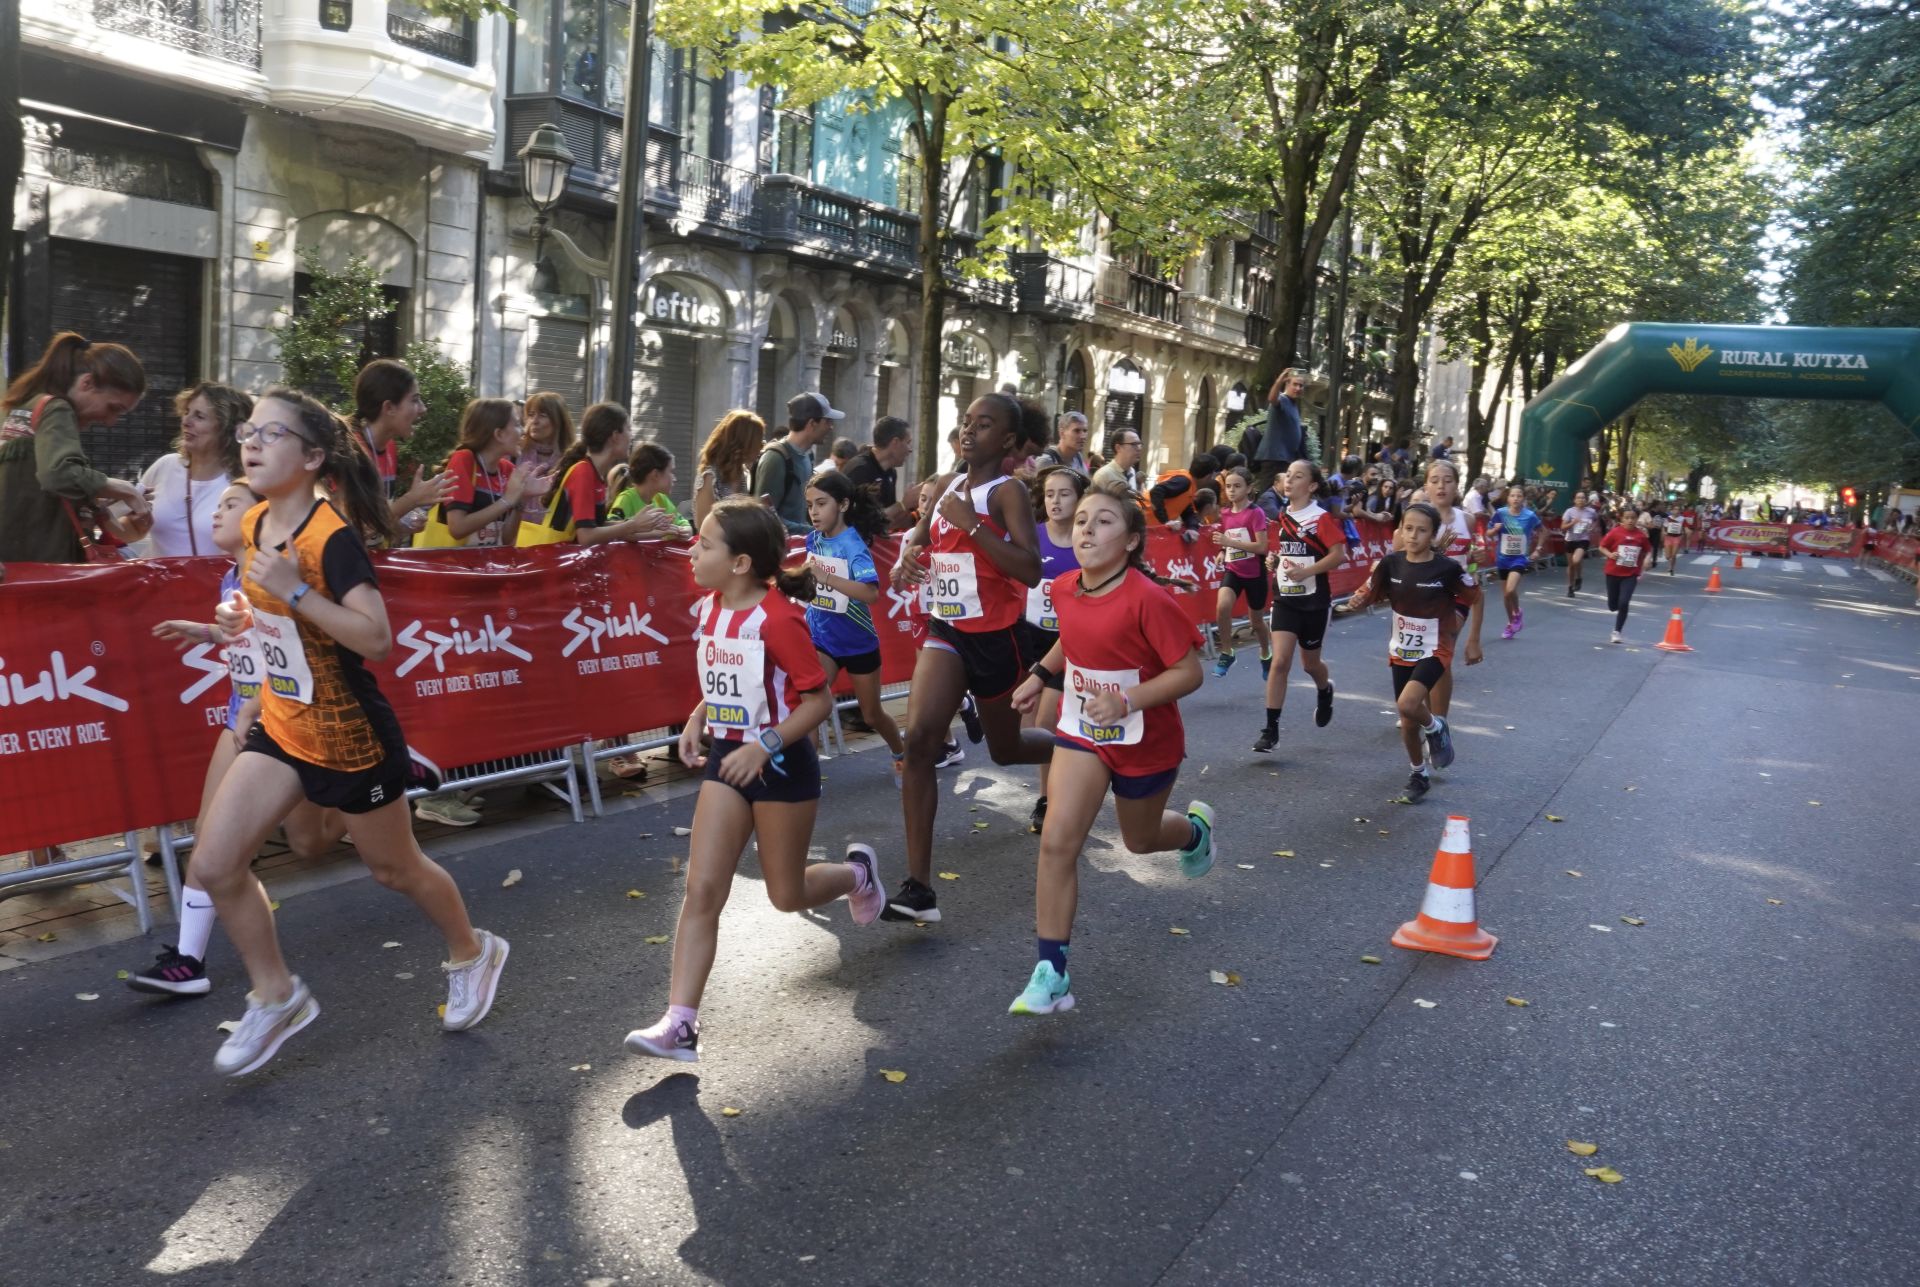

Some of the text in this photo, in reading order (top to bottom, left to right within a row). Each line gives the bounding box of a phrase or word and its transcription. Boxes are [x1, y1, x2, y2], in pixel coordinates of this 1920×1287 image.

[648, 286, 721, 327] lefties
[1720, 350, 1869, 369] RURAL KUTXA
[936, 562, 960, 573] ilbao
[943, 604, 961, 616] BM
[562, 602, 670, 658] Spiuk
[396, 614, 533, 678] Spiuk
[706, 640, 744, 667] Bilbao
[578, 658, 600, 675] EVERY
[623, 653, 648, 670] EVERY
[274, 676, 296, 693] BM
[415, 678, 444, 697] EVERY
[474, 671, 502, 690] EVERY
[706, 671, 743, 698] 961
[719, 707, 745, 722] BM
[0, 721, 111, 756] ER. EVERY RIDE.
[1093, 727, 1121, 741] BM
